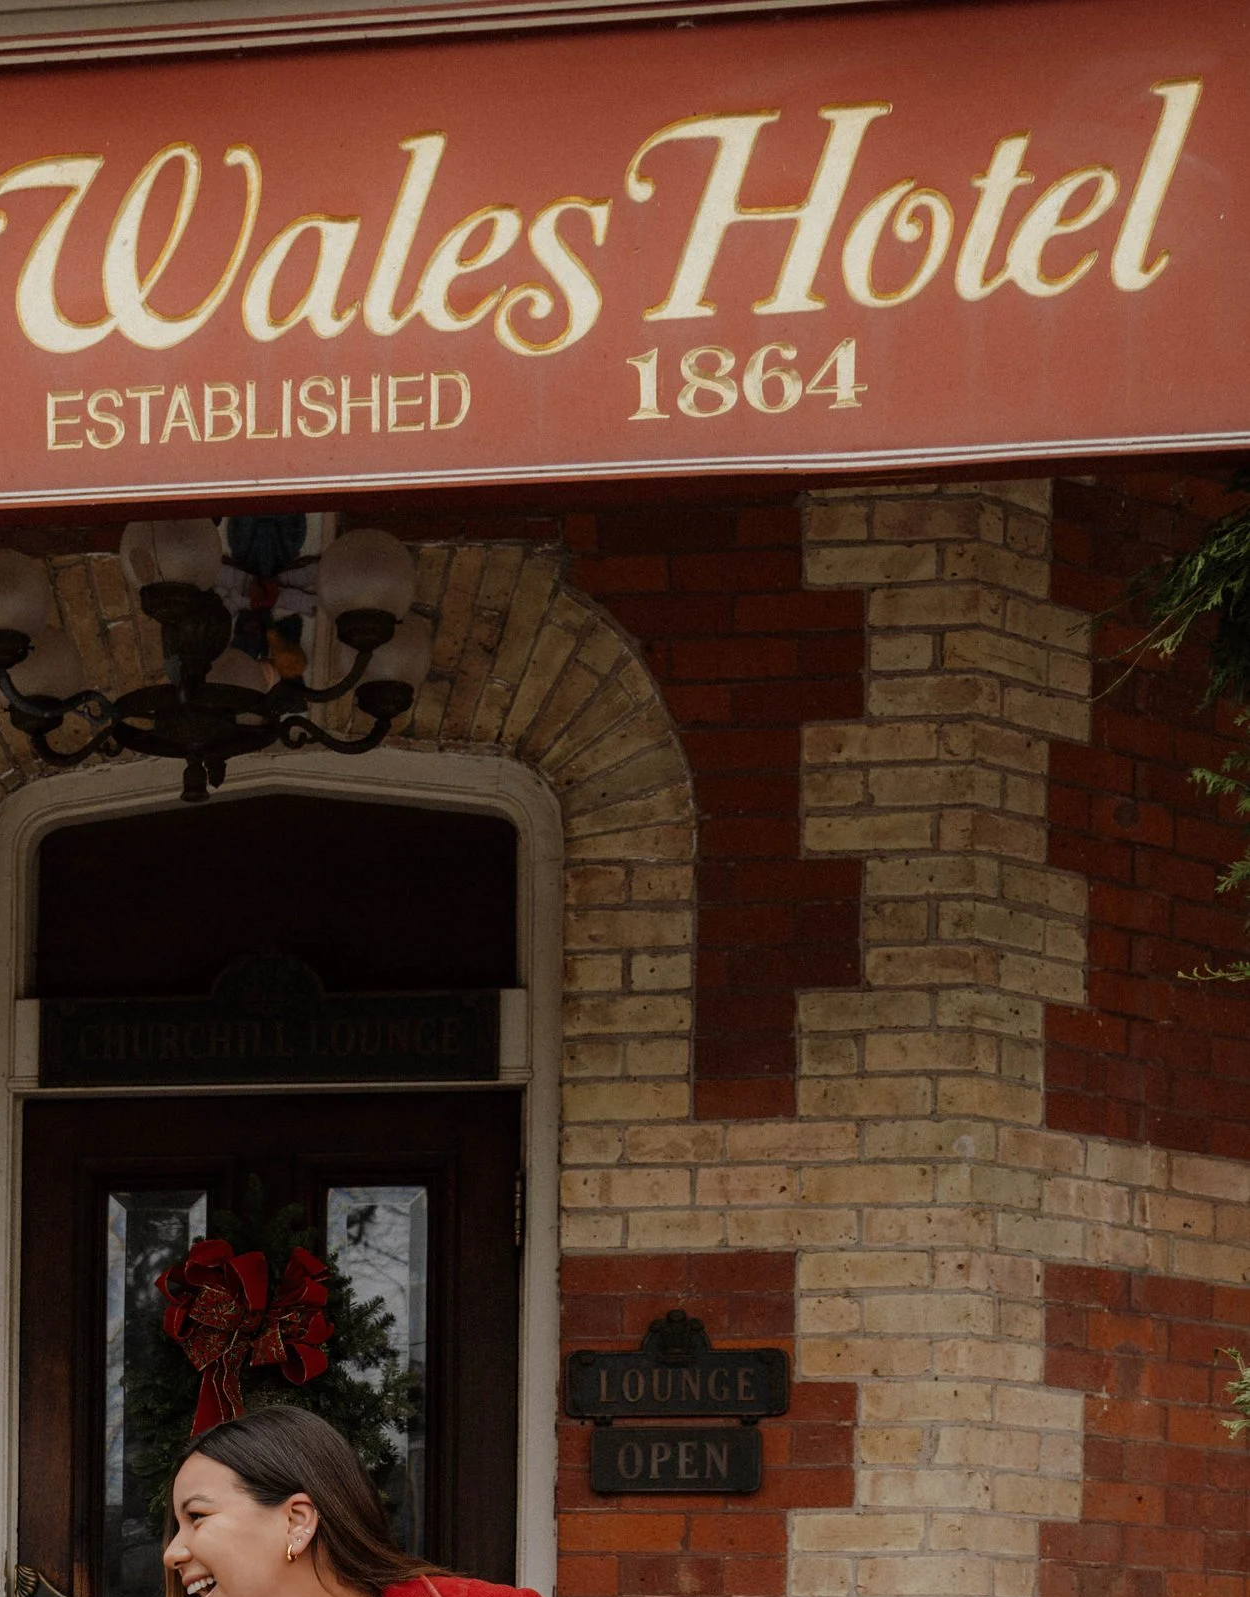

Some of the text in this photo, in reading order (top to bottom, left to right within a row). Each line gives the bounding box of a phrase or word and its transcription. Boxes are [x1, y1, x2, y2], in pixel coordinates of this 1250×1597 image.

[627, 79, 1203, 324] Hotel
[47, 337, 868, 451] ESTABLISHED 1864
[310, 1016, 461, 1056] LOUNGE
[600, 1368, 755, 1403] LOUNGE
[617, 1441, 729, 1480] OPEN
